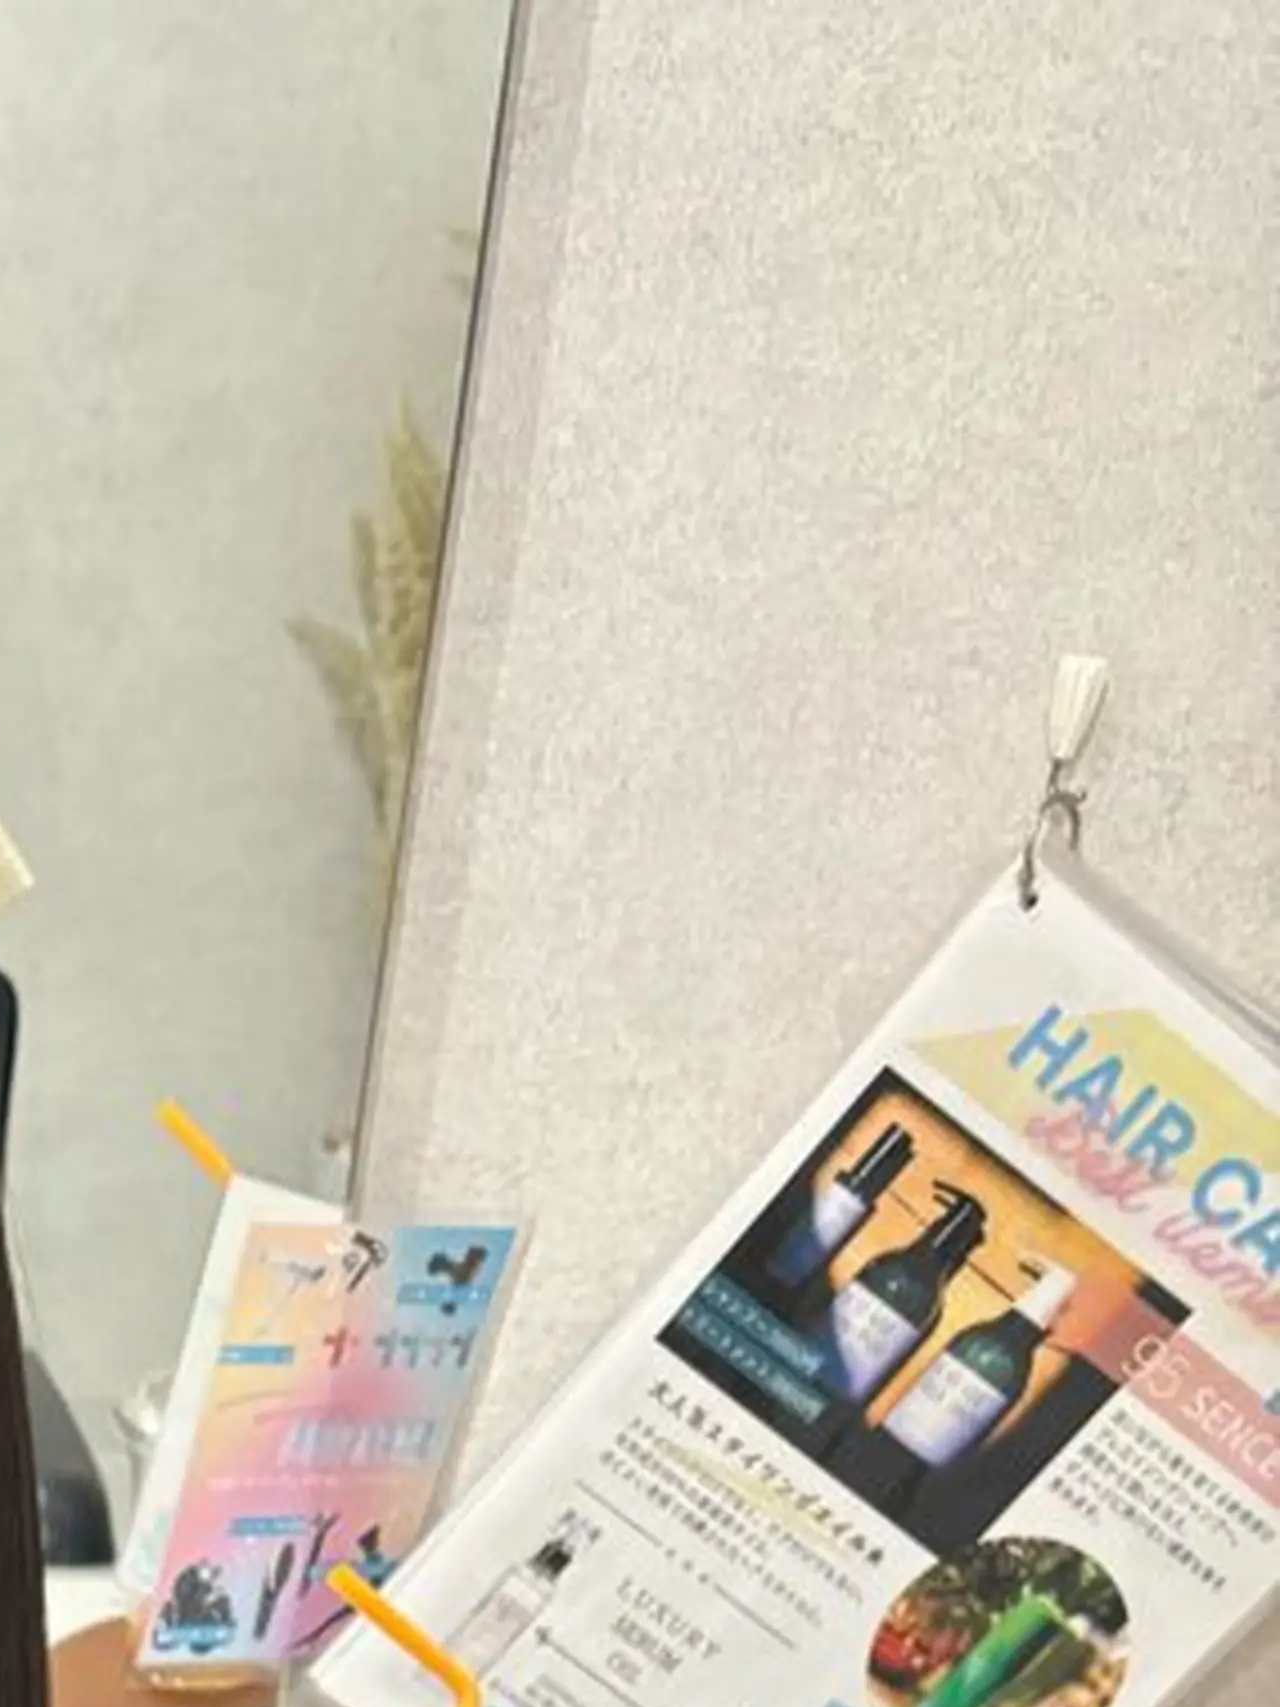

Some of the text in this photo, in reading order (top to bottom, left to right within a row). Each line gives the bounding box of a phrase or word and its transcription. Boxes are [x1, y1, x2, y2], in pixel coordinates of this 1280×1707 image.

[1008, 1004, 1196, 1182] HAIR
[1121, 1333, 1191, 1399] 95
[616, 1575, 722, 1660] LUXURY
